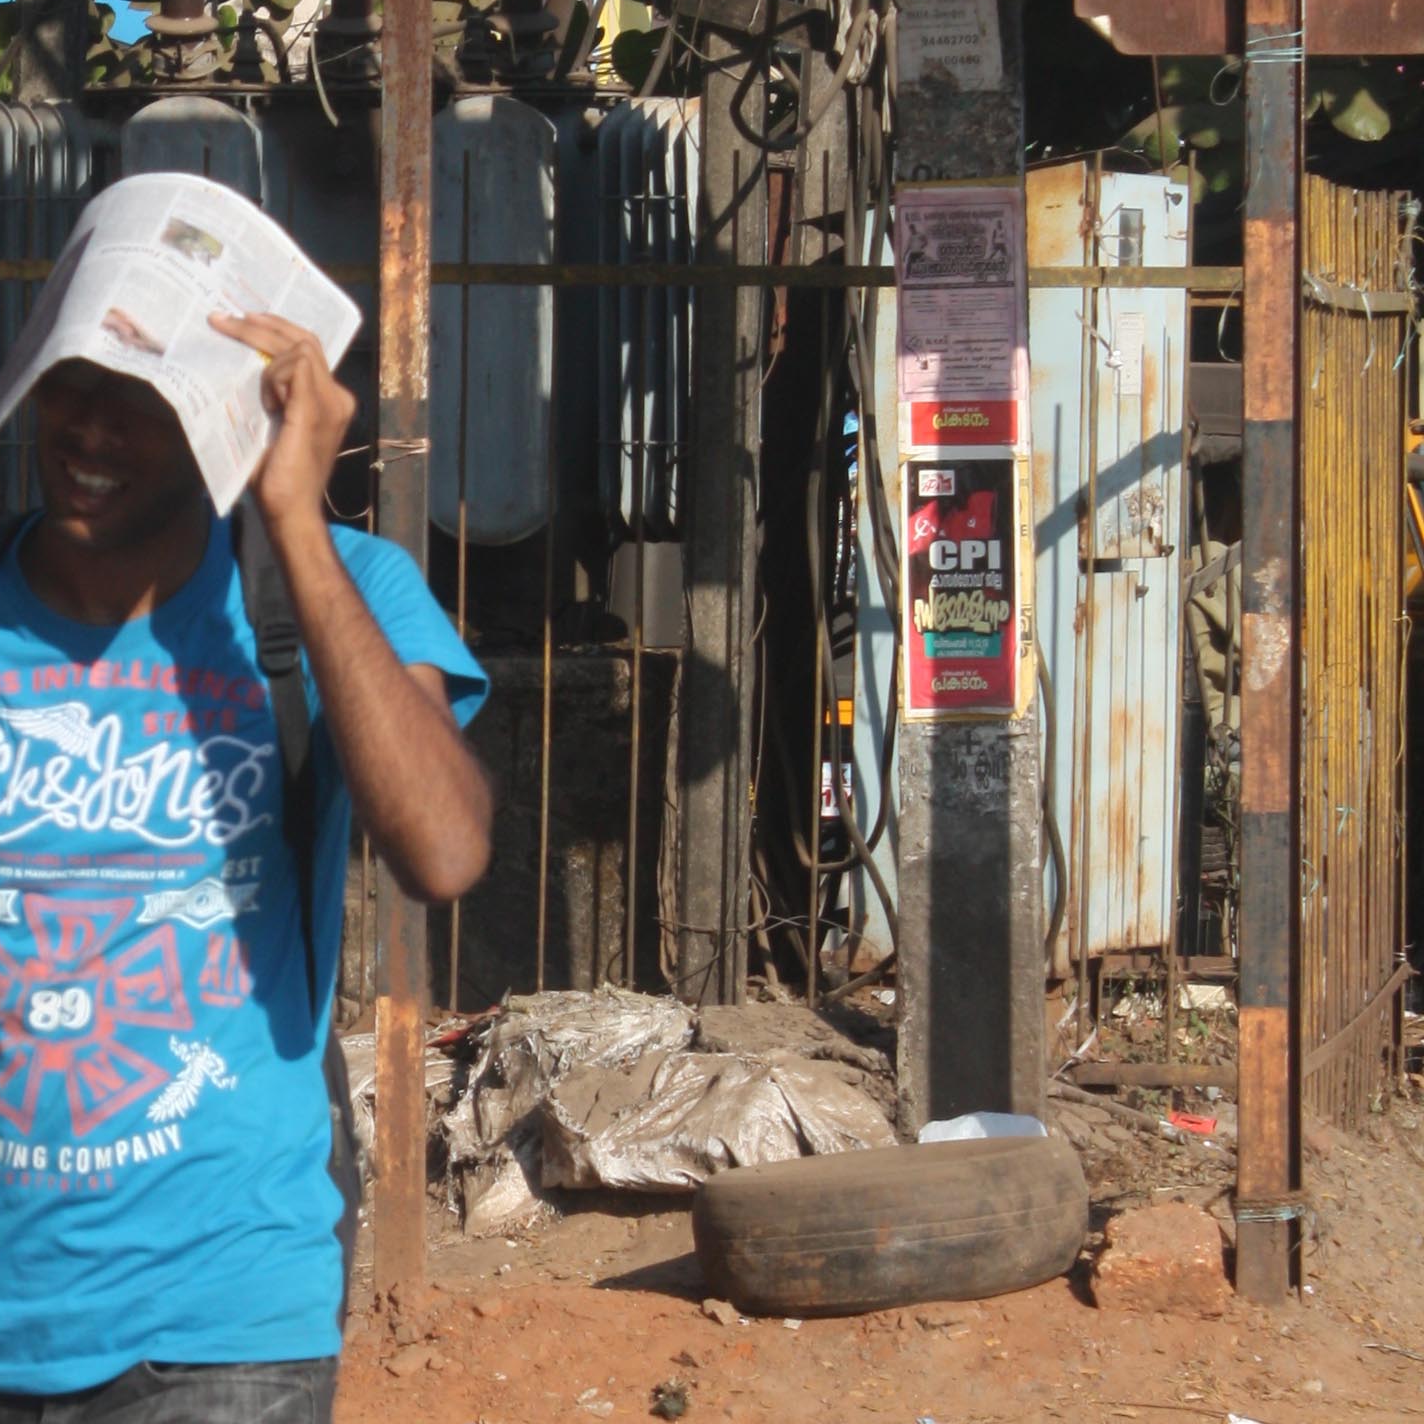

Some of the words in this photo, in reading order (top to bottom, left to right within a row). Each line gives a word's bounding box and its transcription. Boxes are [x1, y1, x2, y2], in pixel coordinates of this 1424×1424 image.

[929, 539, 1001, 571] CPI
[32, 658, 268, 709] INTELLIGENCE
[28, 986, 92, 1032] 89
[58, 1123, 182, 1173] COMPANY
